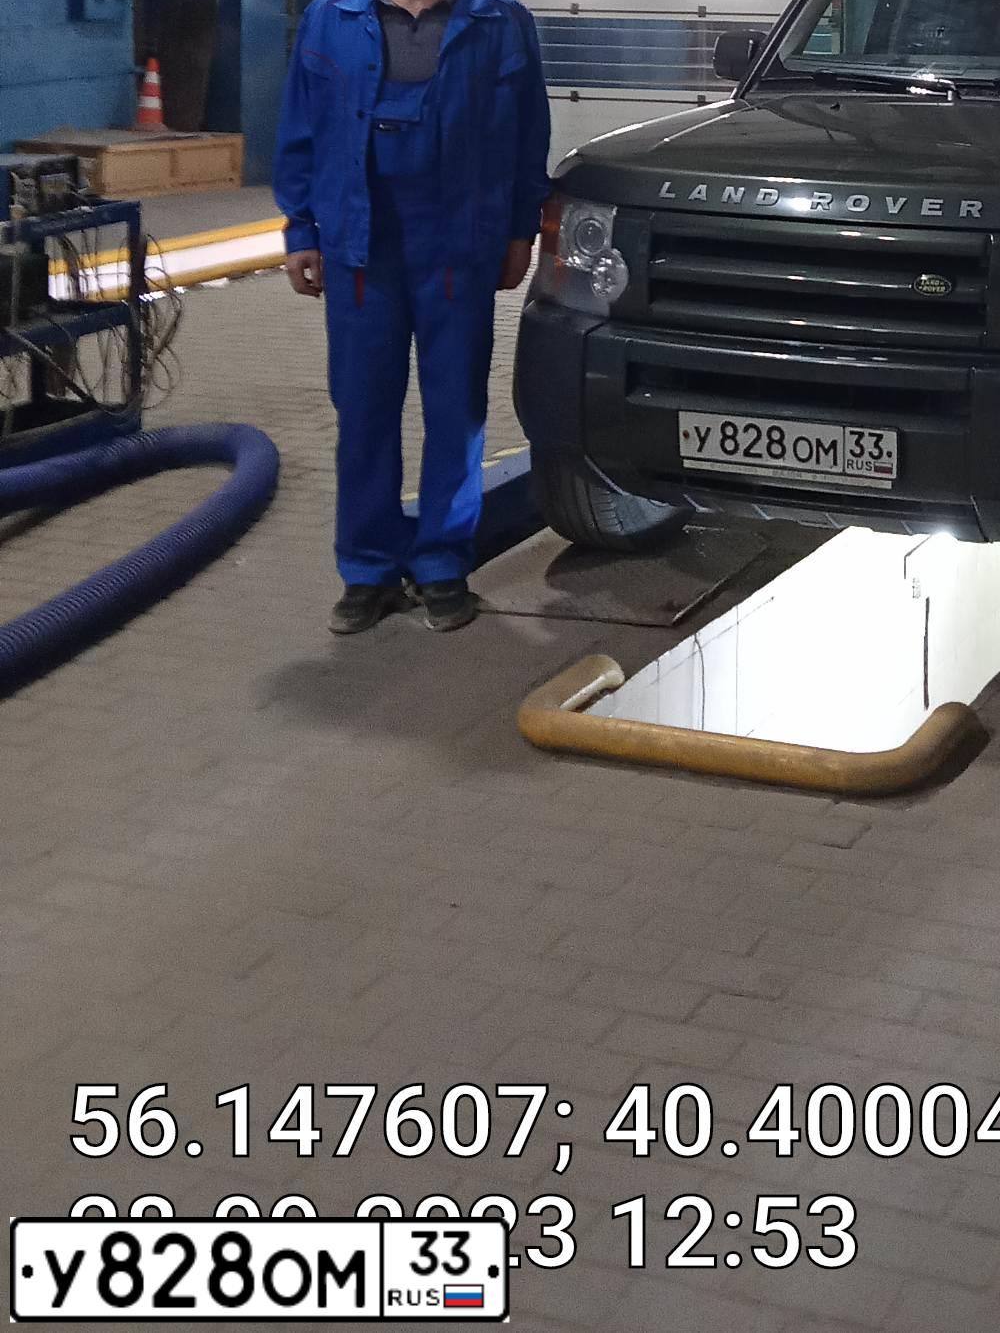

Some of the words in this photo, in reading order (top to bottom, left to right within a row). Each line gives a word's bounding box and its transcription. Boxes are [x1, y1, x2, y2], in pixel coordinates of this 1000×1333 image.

[658, 181, 780, 207] LAND
[810, 191, 984, 218] ROVER
[849, 430, 884, 461] 33
[846, 459, 873, 472] RUS
